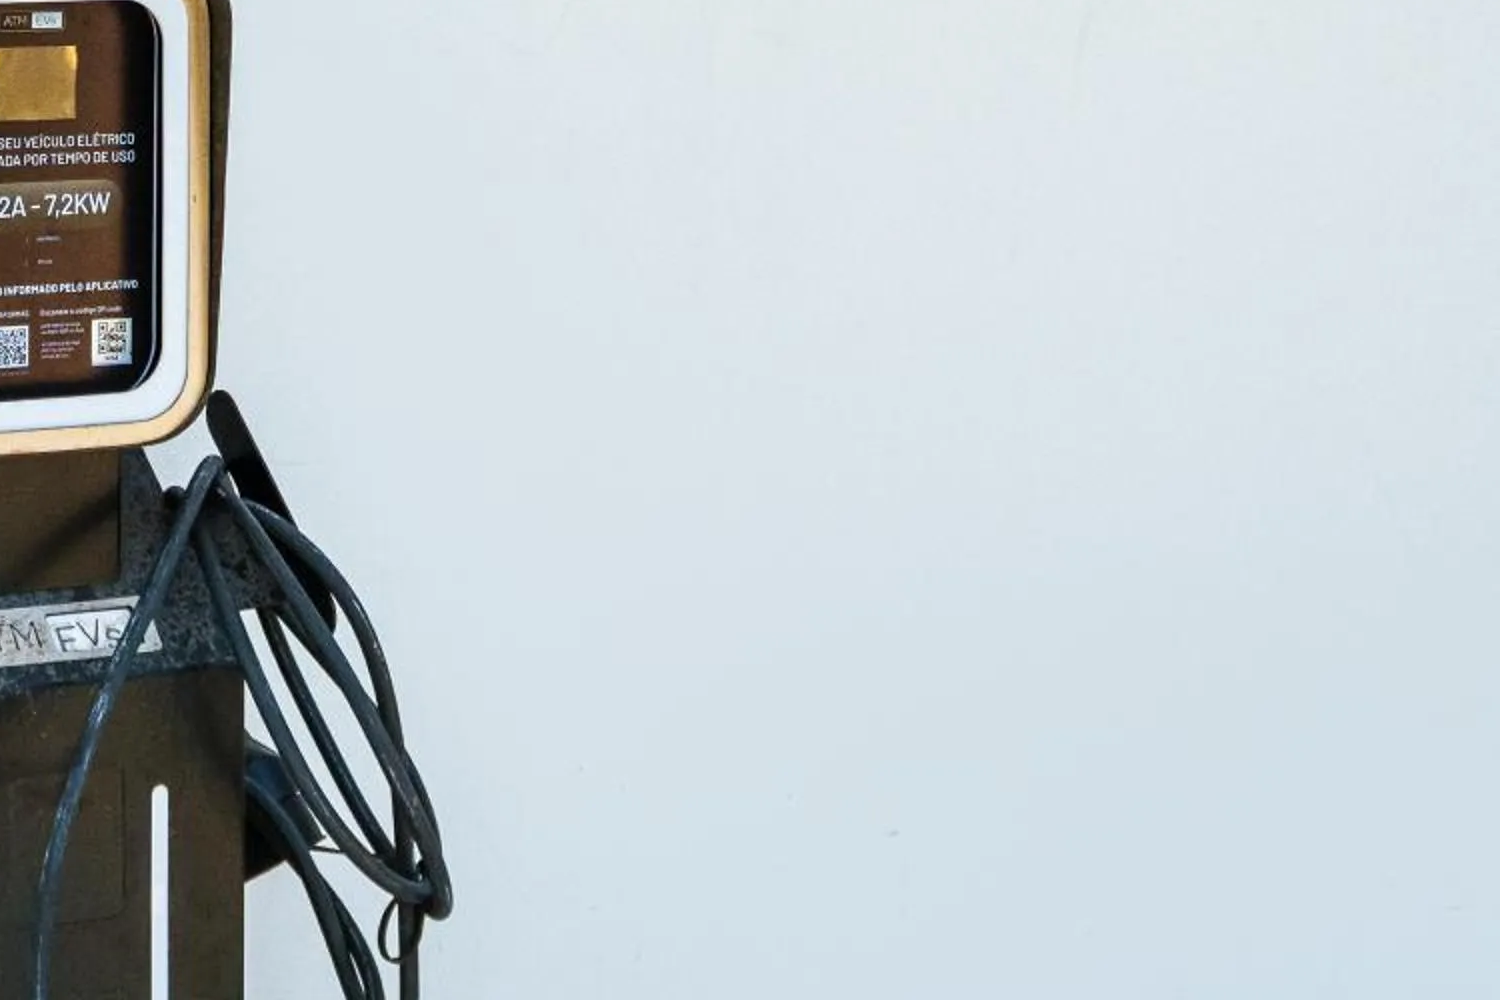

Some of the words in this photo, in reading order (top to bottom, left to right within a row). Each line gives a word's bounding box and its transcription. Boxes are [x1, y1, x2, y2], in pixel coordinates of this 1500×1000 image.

[24, 132, 75, 149] VEÍCULO
[77, 131, 135, 148] ELÉTRICO
[23, 153, 49, 167] POR
[50, 151, 90, 165] TEMPO
[93, 151, 108, 163] DE
[111, 149, 135, 163] USO
[44, 192, 111, 218] 7,2KW
[4, 283, 58, 297] INFORMADO
[85, 279, 139, 292] APLICATIVO
